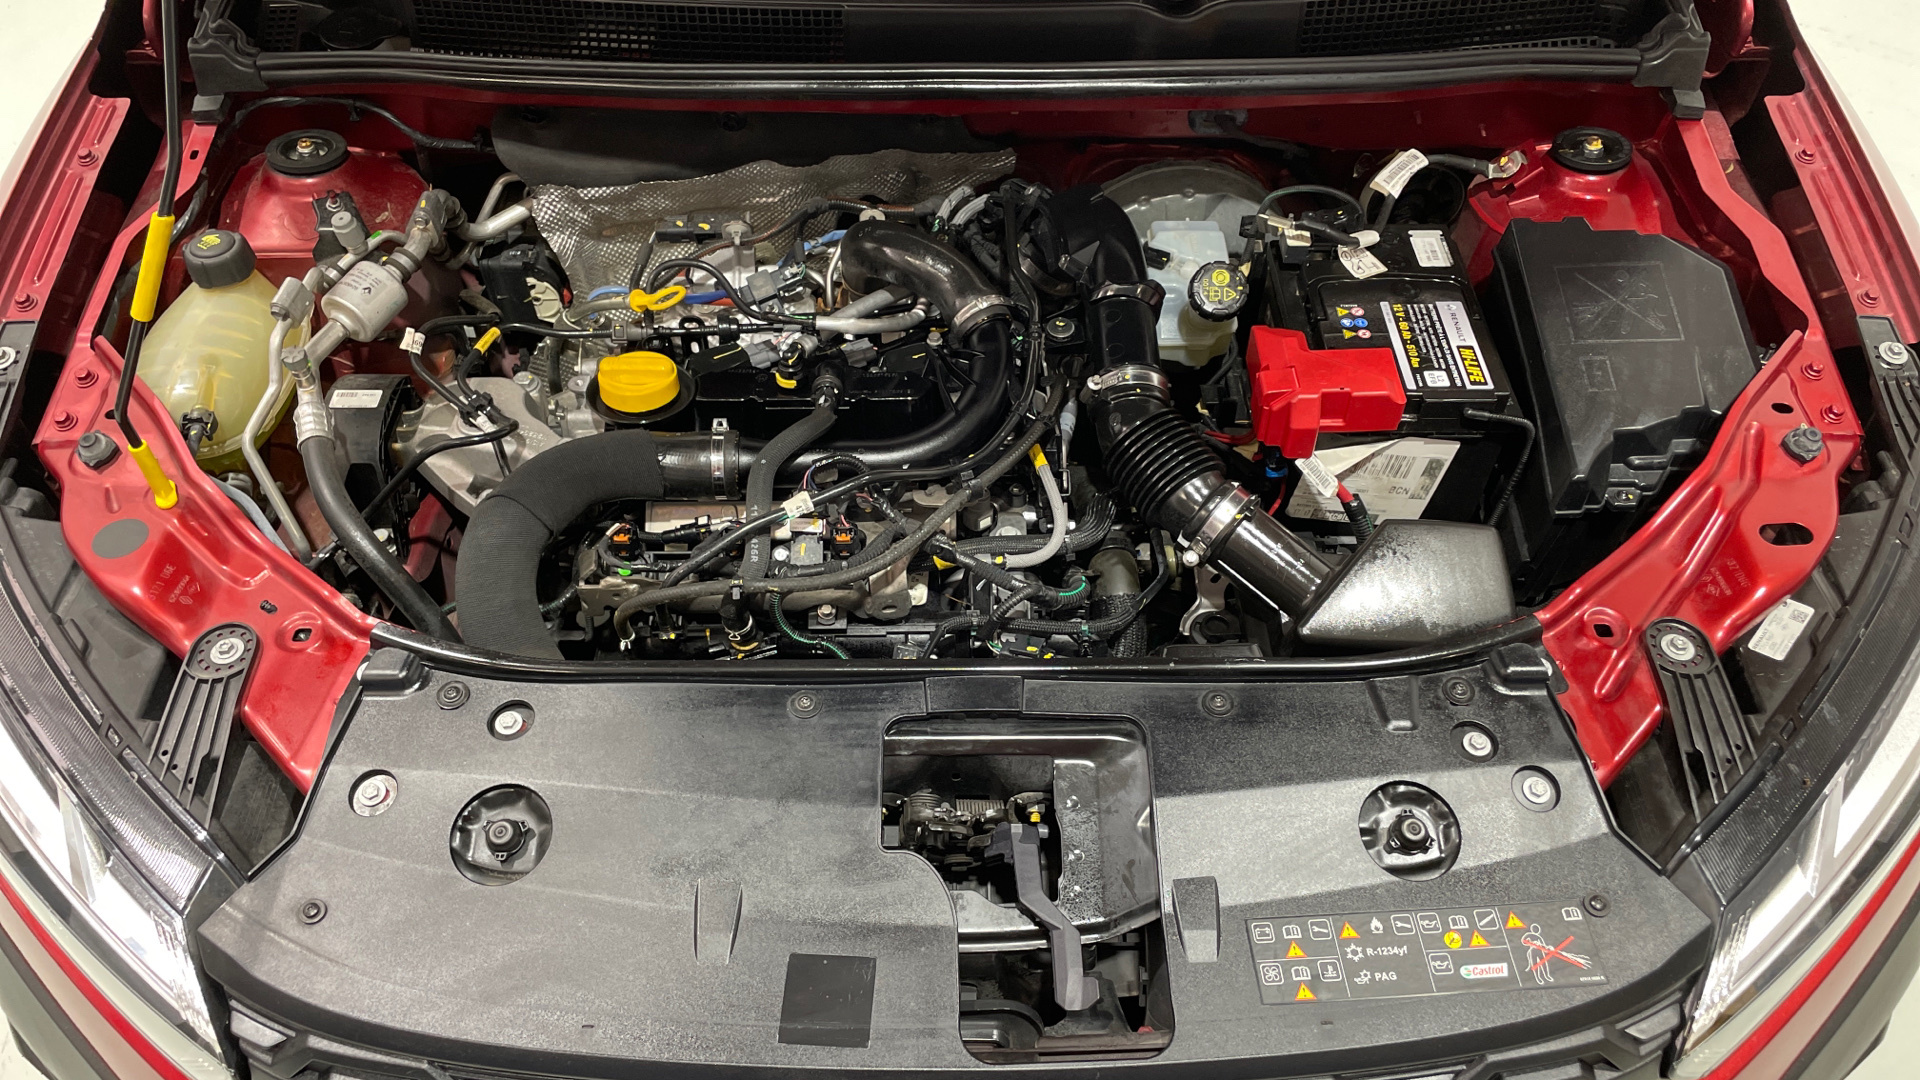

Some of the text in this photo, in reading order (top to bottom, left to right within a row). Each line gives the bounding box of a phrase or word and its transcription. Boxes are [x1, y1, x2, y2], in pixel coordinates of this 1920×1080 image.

[1398, 322, 1409, 330] 60
[1449, 312, 1466, 342] RENAULT
[1401, 330, 1412, 339] Ah
[1406, 344, 1418, 356] 510
[1428, 373, 1437, 385] EFB
[1436, 375, 1444, 383] L2
[1388, 486, 1410, 495] BCN
[1366, 945, 1408, 956] R-1234yf
[1472, 963, 1504, 976] Castrol
[1374, 971, 1397, 981] PAG
